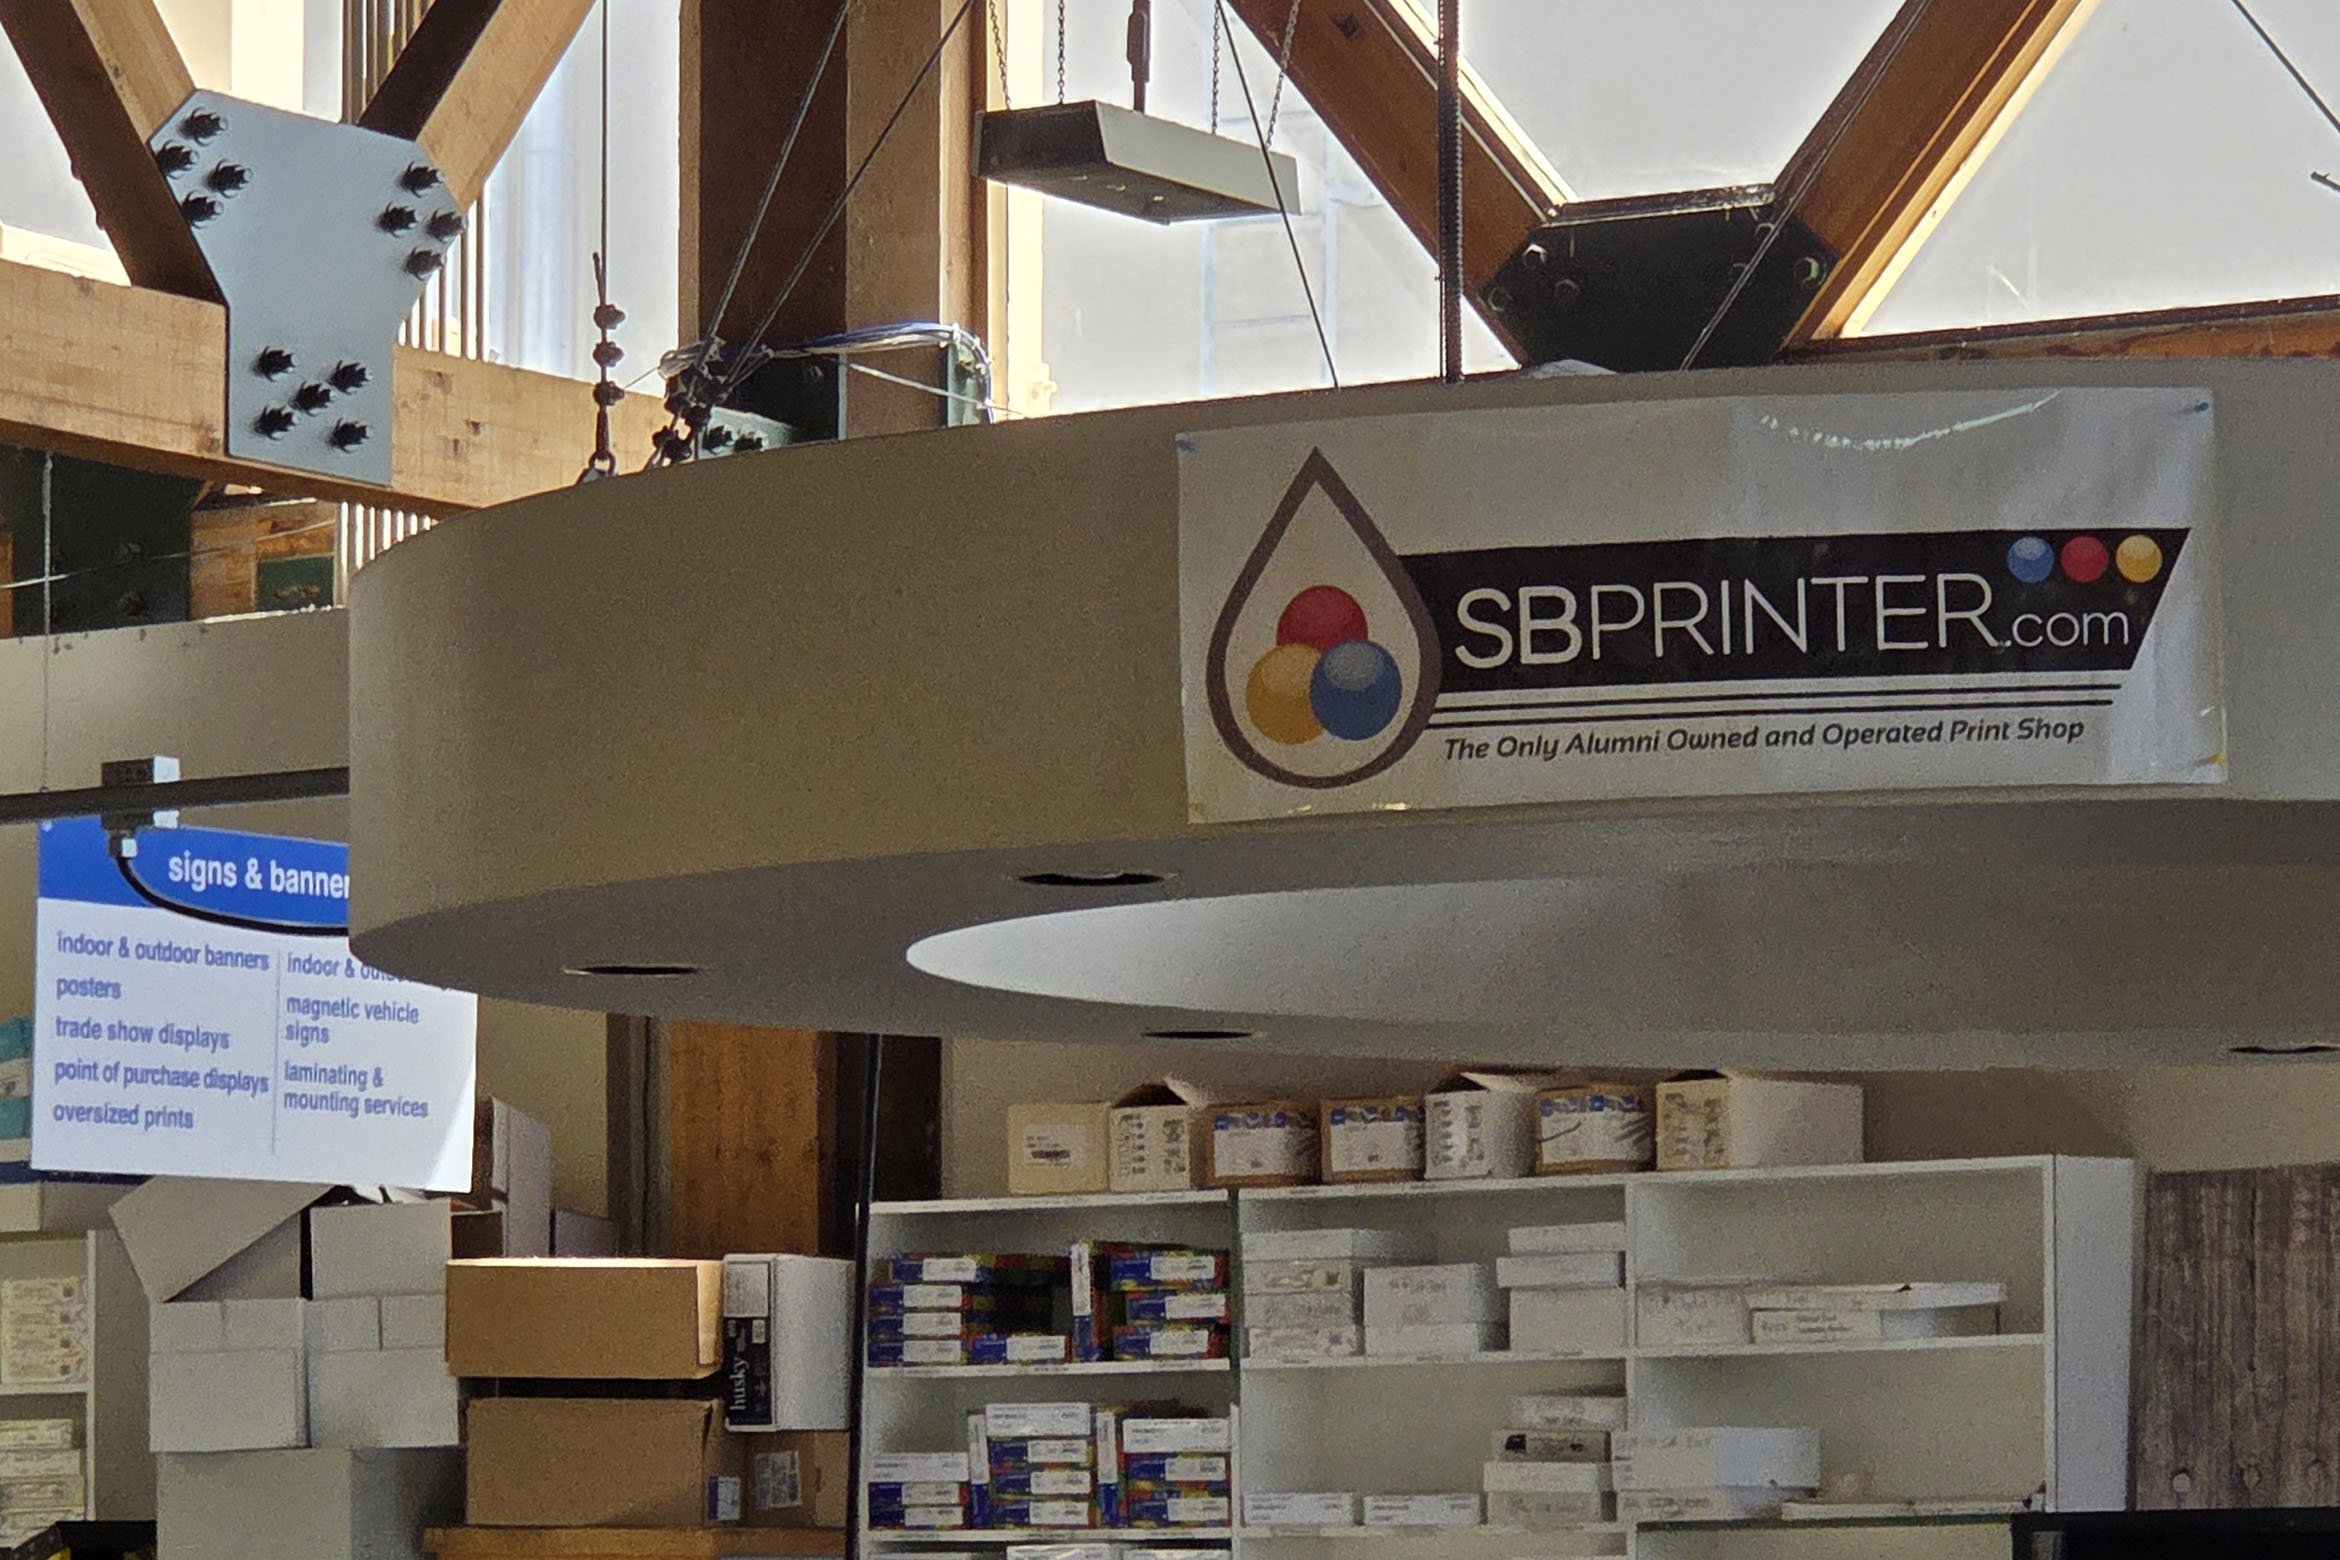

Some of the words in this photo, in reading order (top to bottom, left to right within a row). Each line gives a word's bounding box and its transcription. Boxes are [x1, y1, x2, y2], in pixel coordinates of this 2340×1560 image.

[1456, 573, 2130, 669] SBPRINTER.com
[1446, 738, 1489, 760] The
[1497, 735, 1559, 761] Only
[1564, 730, 1659, 754] Alumni
[1667, 727, 1758, 750] Owned
[1765, 724, 1815, 747] and
[1822, 720, 1943, 749] Operated
[1949, 718, 2009, 742] Print
[2016, 717, 2085, 743] Shop
[168, 850, 237, 893] signs
[244, 858, 263, 890] &
[57, 932, 113, 956] indoor
[118, 936, 130, 958] &
[135, 940, 201, 964] outdoor
[204, 944, 269, 970] banners
[287, 952, 339, 977] indoor
[345, 958, 355, 978] &
[56, 977, 121, 1000] posters
[286, 997, 360, 1021] magnetic
[364, 1000, 419, 1024] vehicle
[56, 1016, 101, 1040] trade
[107, 1020, 154, 1043] show
[158, 1023, 230, 1054] displays
[285, 1020, 329, 1047] signs
[54, 1059, 98, 1084] point
[102, 1061, 120, 1083] of
[123, 1065, 200, 1089] purchase
[203, 1068, 270, 1098] displays
[284, 1060, 368, 1092] laminating
[372, 1067, 384, 1088] &
[53, 1102, 139, 1126] oversized
[144, 1106, 194, 1131] prints
[284, 1091, 360, 1118] mounting
[364, 1097, 429, 1118] services
[729, 1359, 749, 1411] husky
